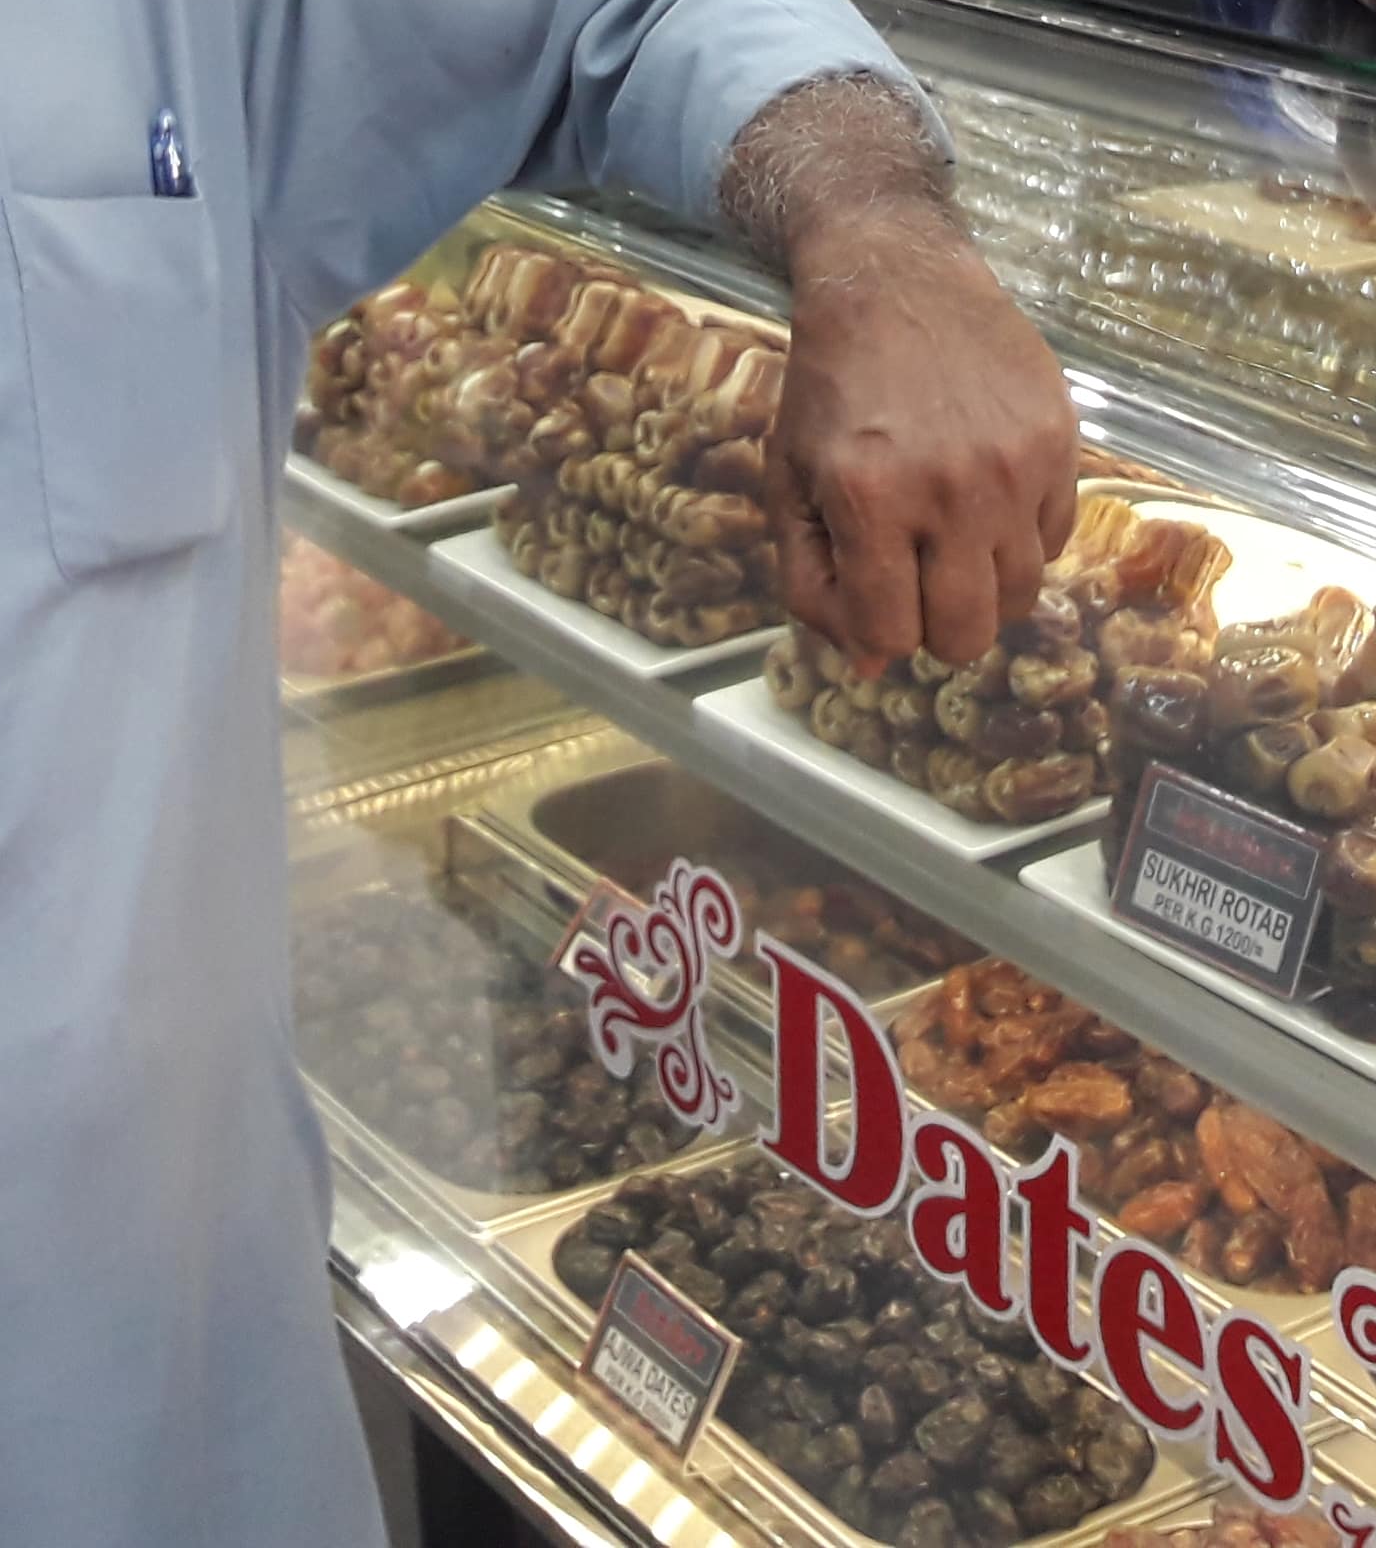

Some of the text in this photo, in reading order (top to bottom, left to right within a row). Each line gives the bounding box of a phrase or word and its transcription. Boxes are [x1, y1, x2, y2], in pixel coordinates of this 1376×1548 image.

[1142, 853, 1289, 941] SUKHRI ROTAB
[1152, 893, 1183, 925] PER
[755, 936, 1308, 1507] Dates
[643, 1364, 695, 1421] DATES
